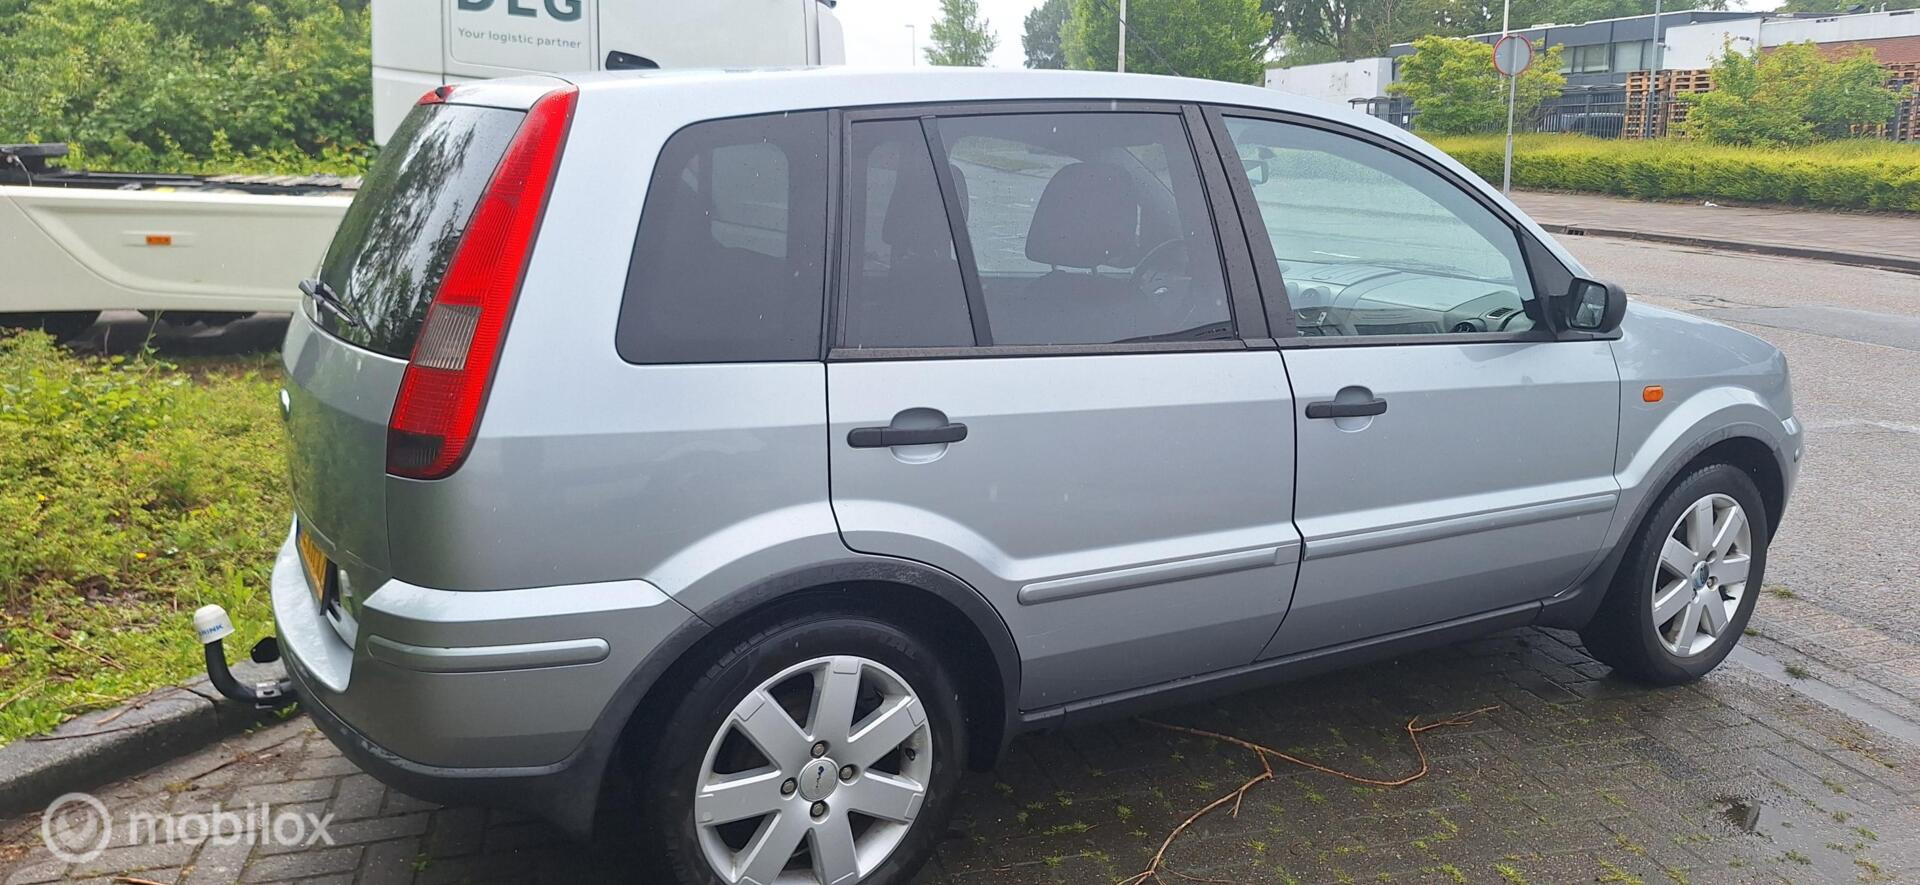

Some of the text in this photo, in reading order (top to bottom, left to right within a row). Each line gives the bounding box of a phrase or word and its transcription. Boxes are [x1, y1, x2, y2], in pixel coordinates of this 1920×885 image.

[458, 27, 581, 48] Your logistic partner
